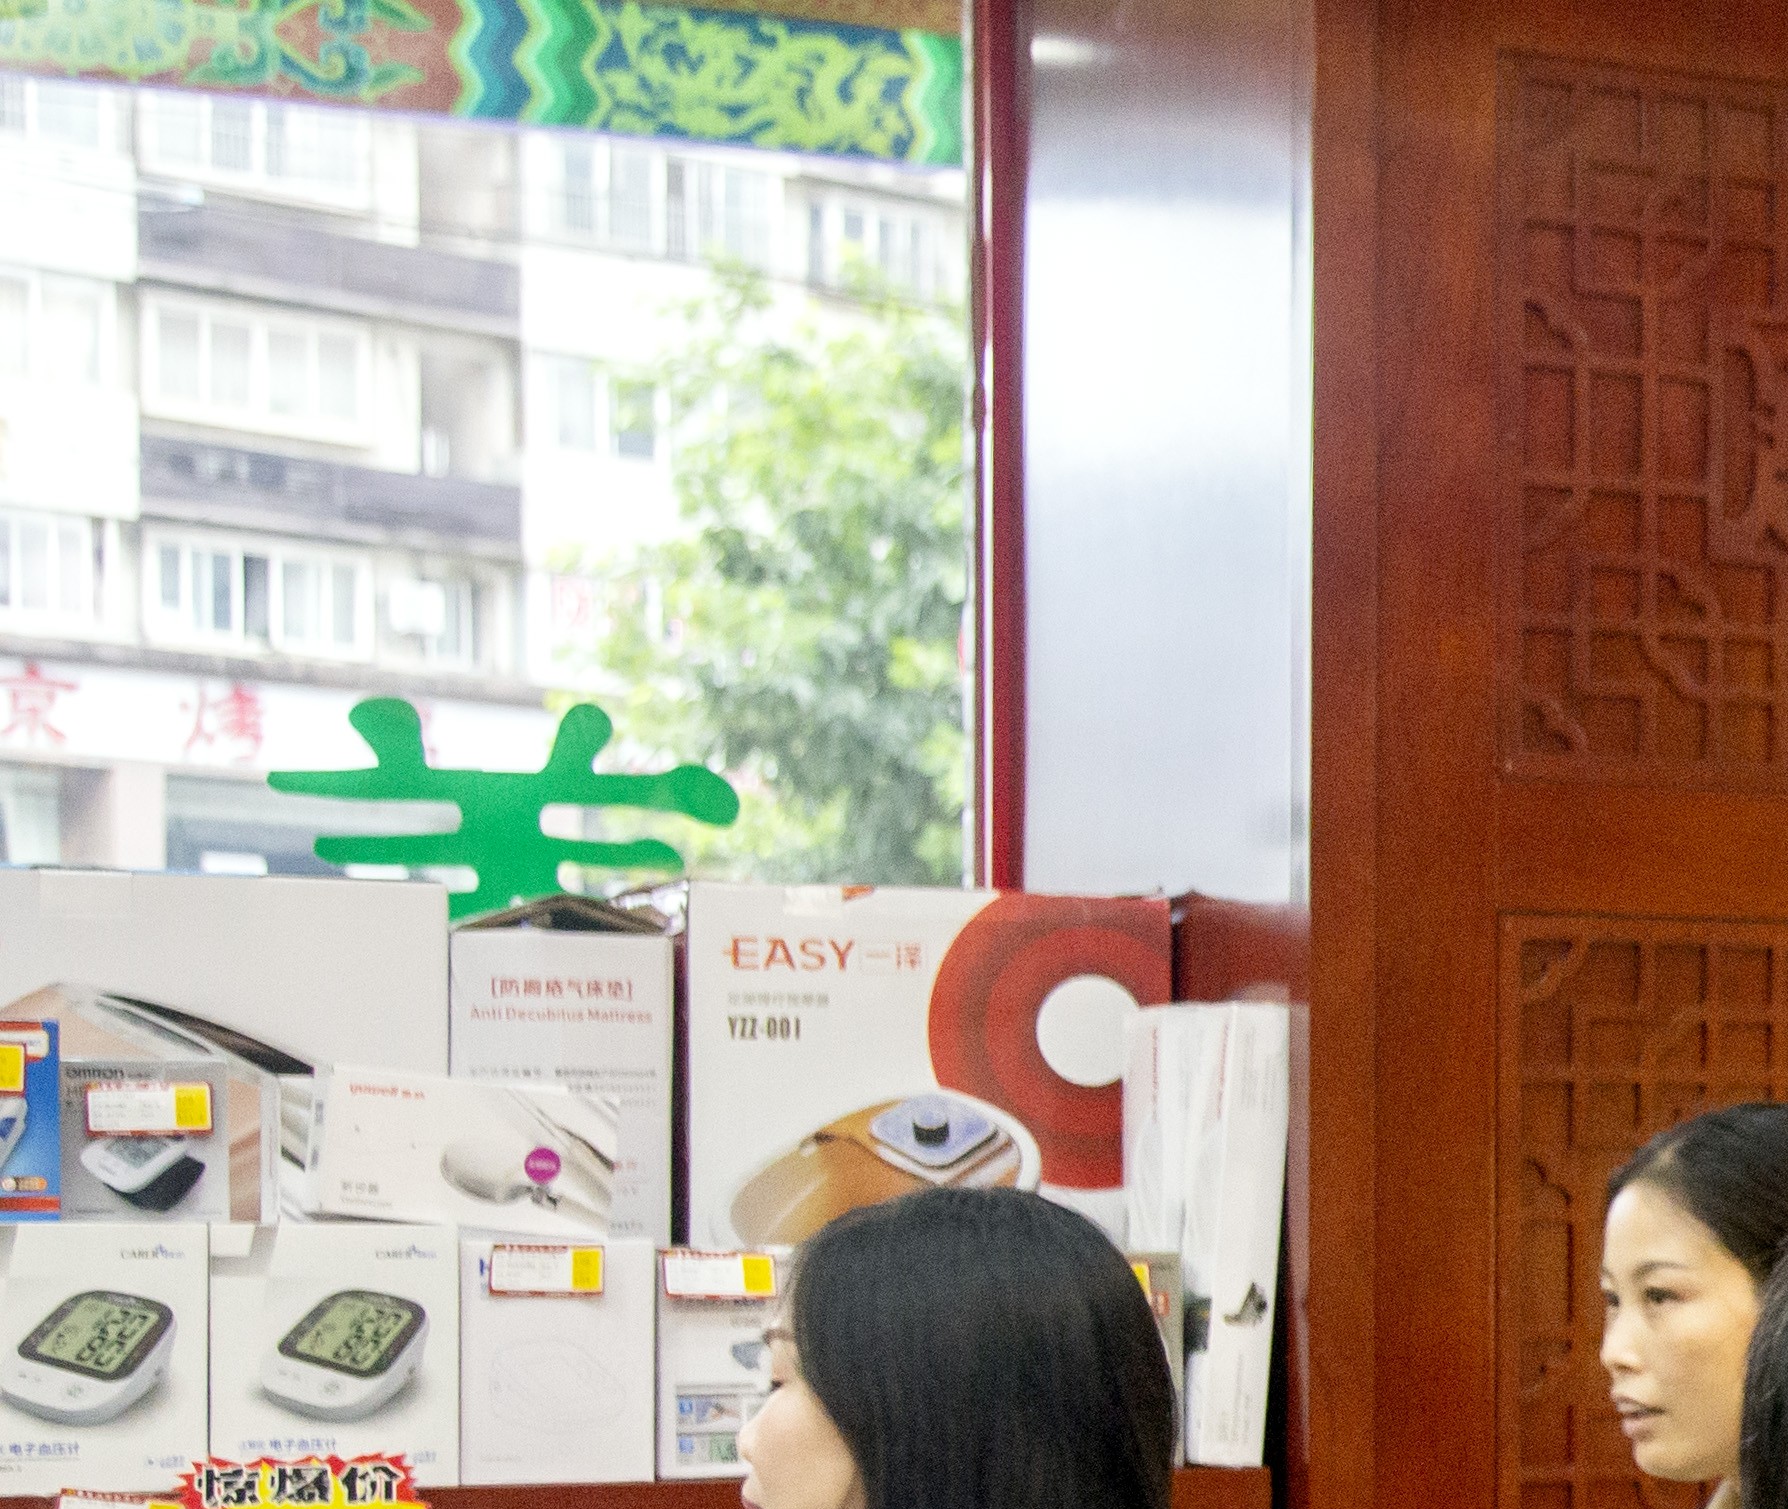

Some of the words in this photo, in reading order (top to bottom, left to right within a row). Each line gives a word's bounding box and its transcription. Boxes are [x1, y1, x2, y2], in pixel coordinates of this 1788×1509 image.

[723, 935, 854, 972] EASY
[198, 1464, 401, 1505] 惊爆价
